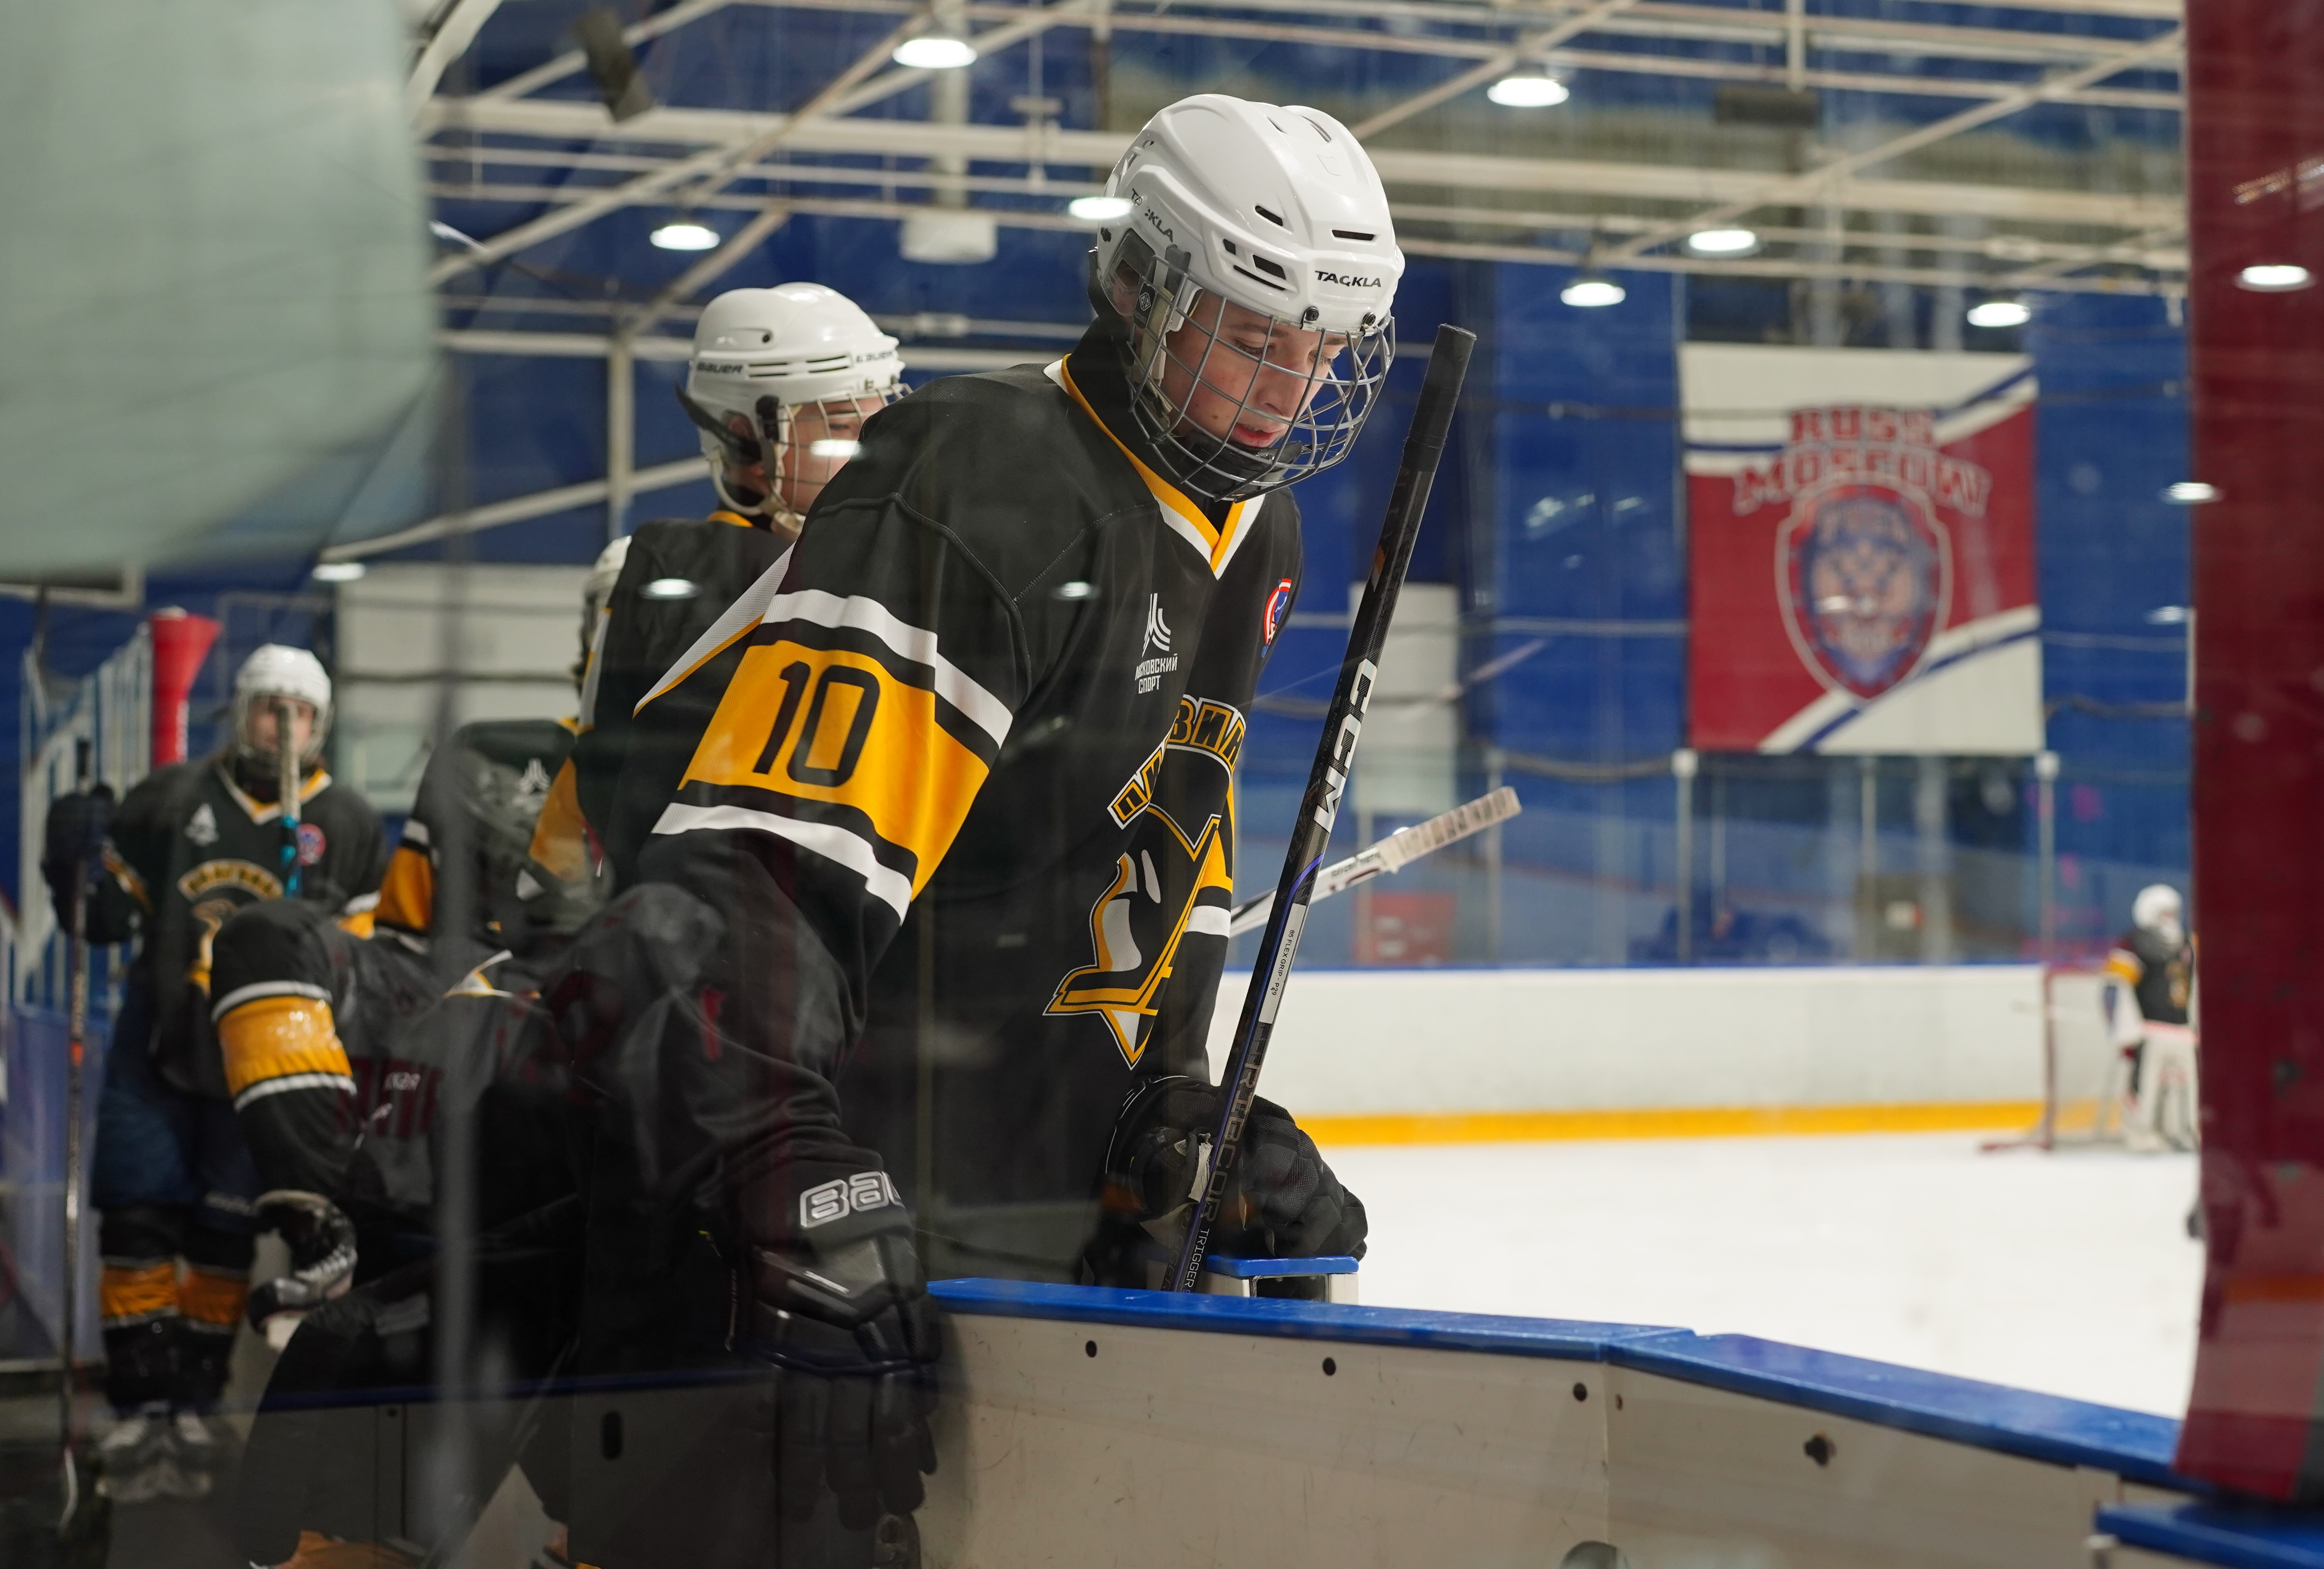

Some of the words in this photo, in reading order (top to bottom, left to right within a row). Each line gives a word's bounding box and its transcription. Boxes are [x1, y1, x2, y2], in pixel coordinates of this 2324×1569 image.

[1315, 270, 1381, 287] TACKLA
[1138, 675, 1161, 694] СПОРТ
[752, 660, 880, 788] 10
[1313, 658, 1378, 833] CCM
[1288, 930, 1295, 938] 85
[1282, 939, 1292, 958] FLEX
[1278, 959, 1286, 977] GRIP
[1201, 1063, 1262, 1222] RIBCOR
[1185, 1229, 1210, 1288] TRIGGER
